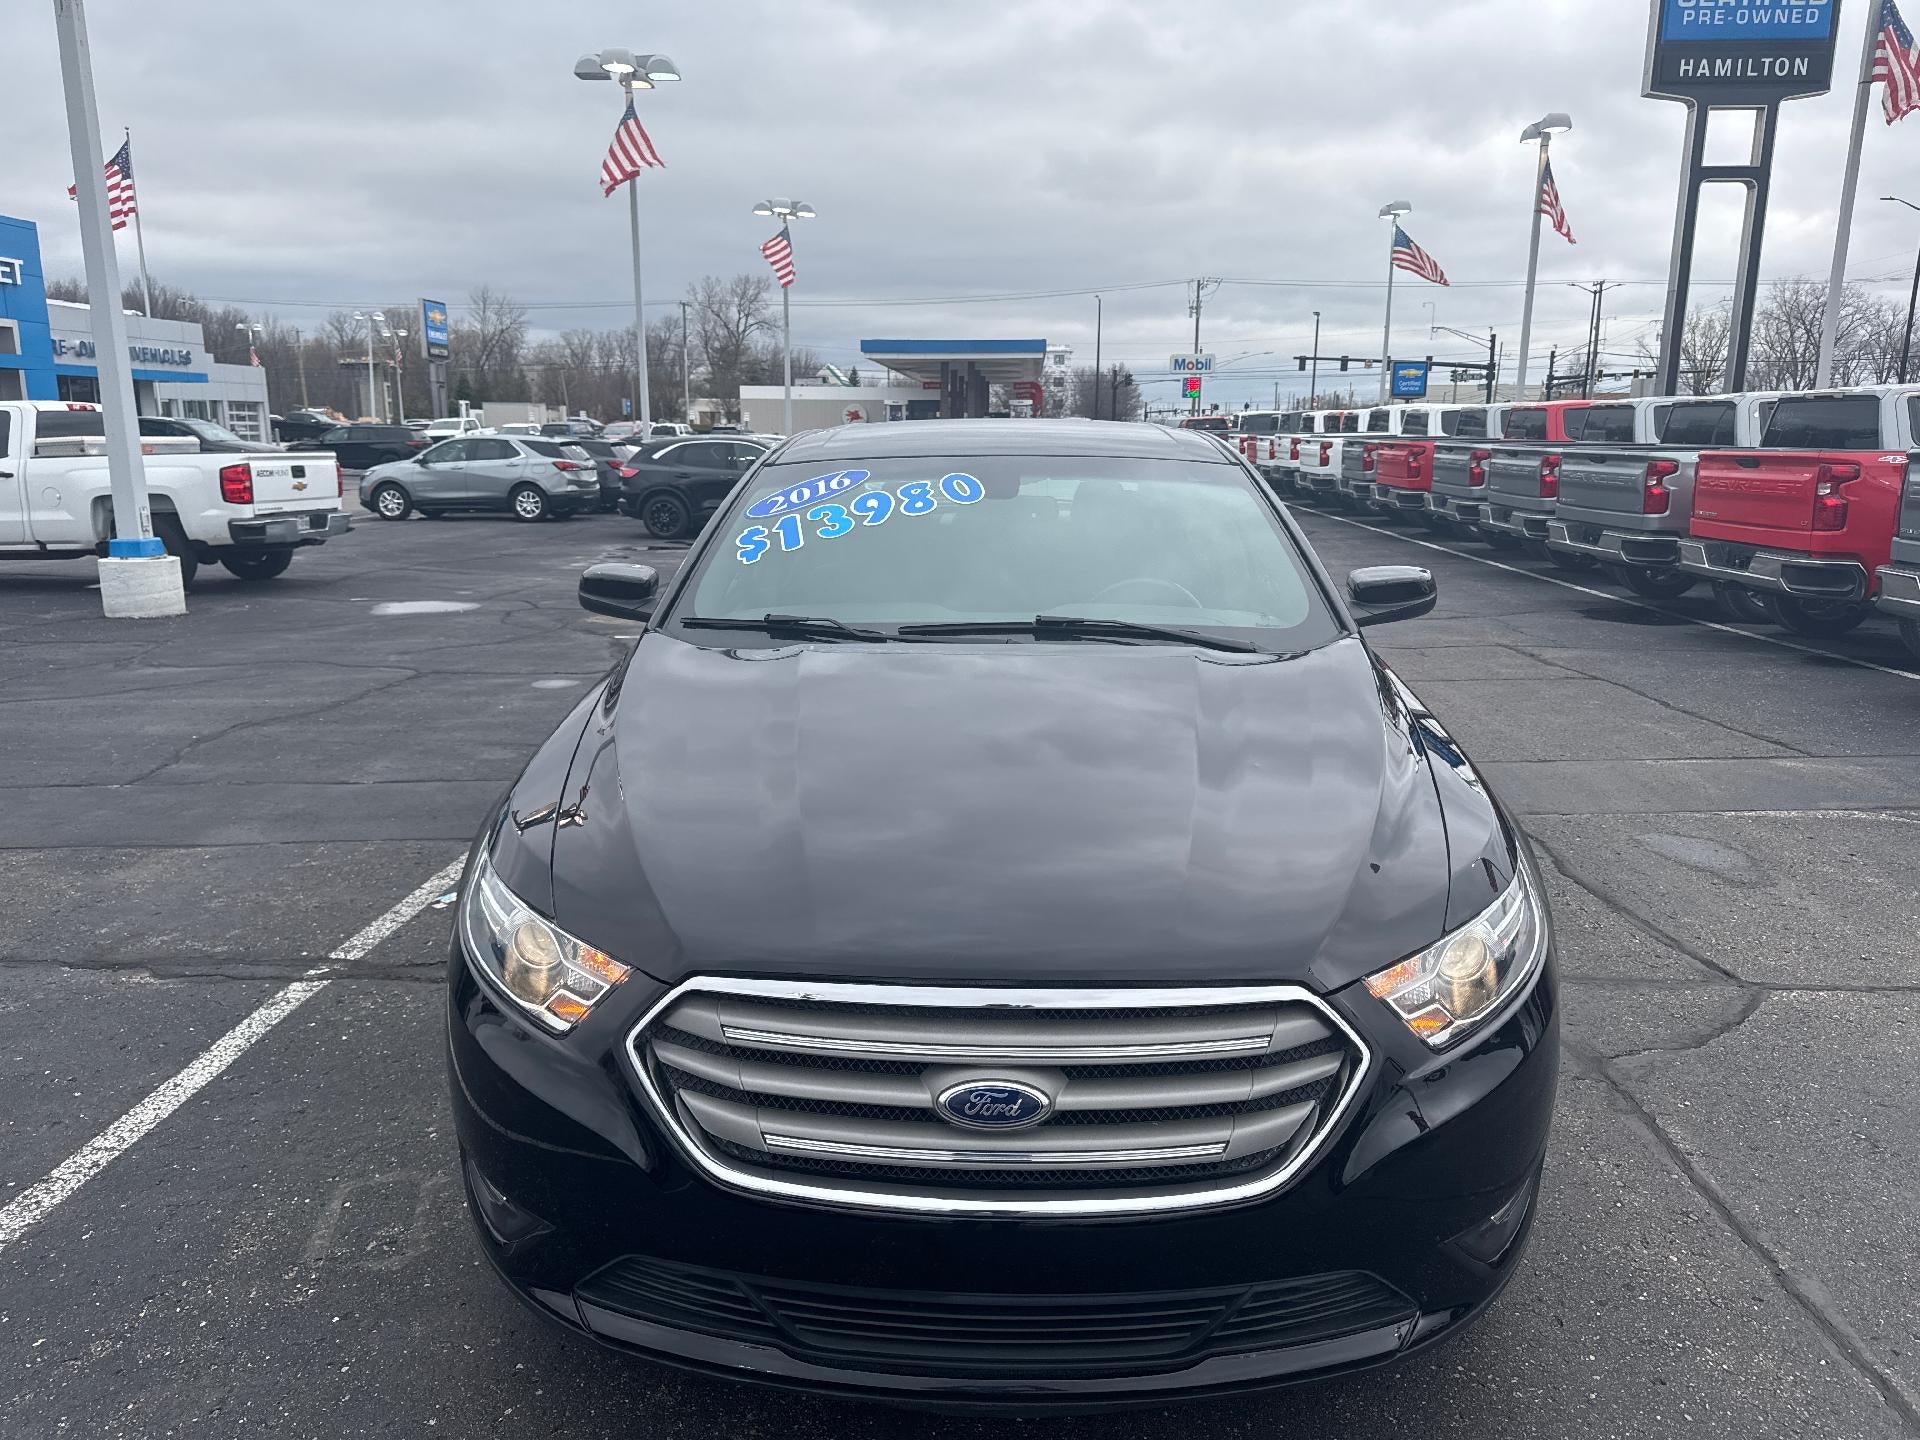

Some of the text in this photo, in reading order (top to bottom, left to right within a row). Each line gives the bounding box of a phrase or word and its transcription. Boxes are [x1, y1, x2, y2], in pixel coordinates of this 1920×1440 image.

[1683, 8, 1820, 25] PRE-OWNED
[1679, 57, 1809, 77] HAMILTON
[134, 346, 192, 365] VEHICLES
[1174, 358, 1211, 371] Mobil
[768, 472, 852, 515] 2016
[735, 472, 986, 565] $13980
[964, 1090, 1022, 1117] Ford
